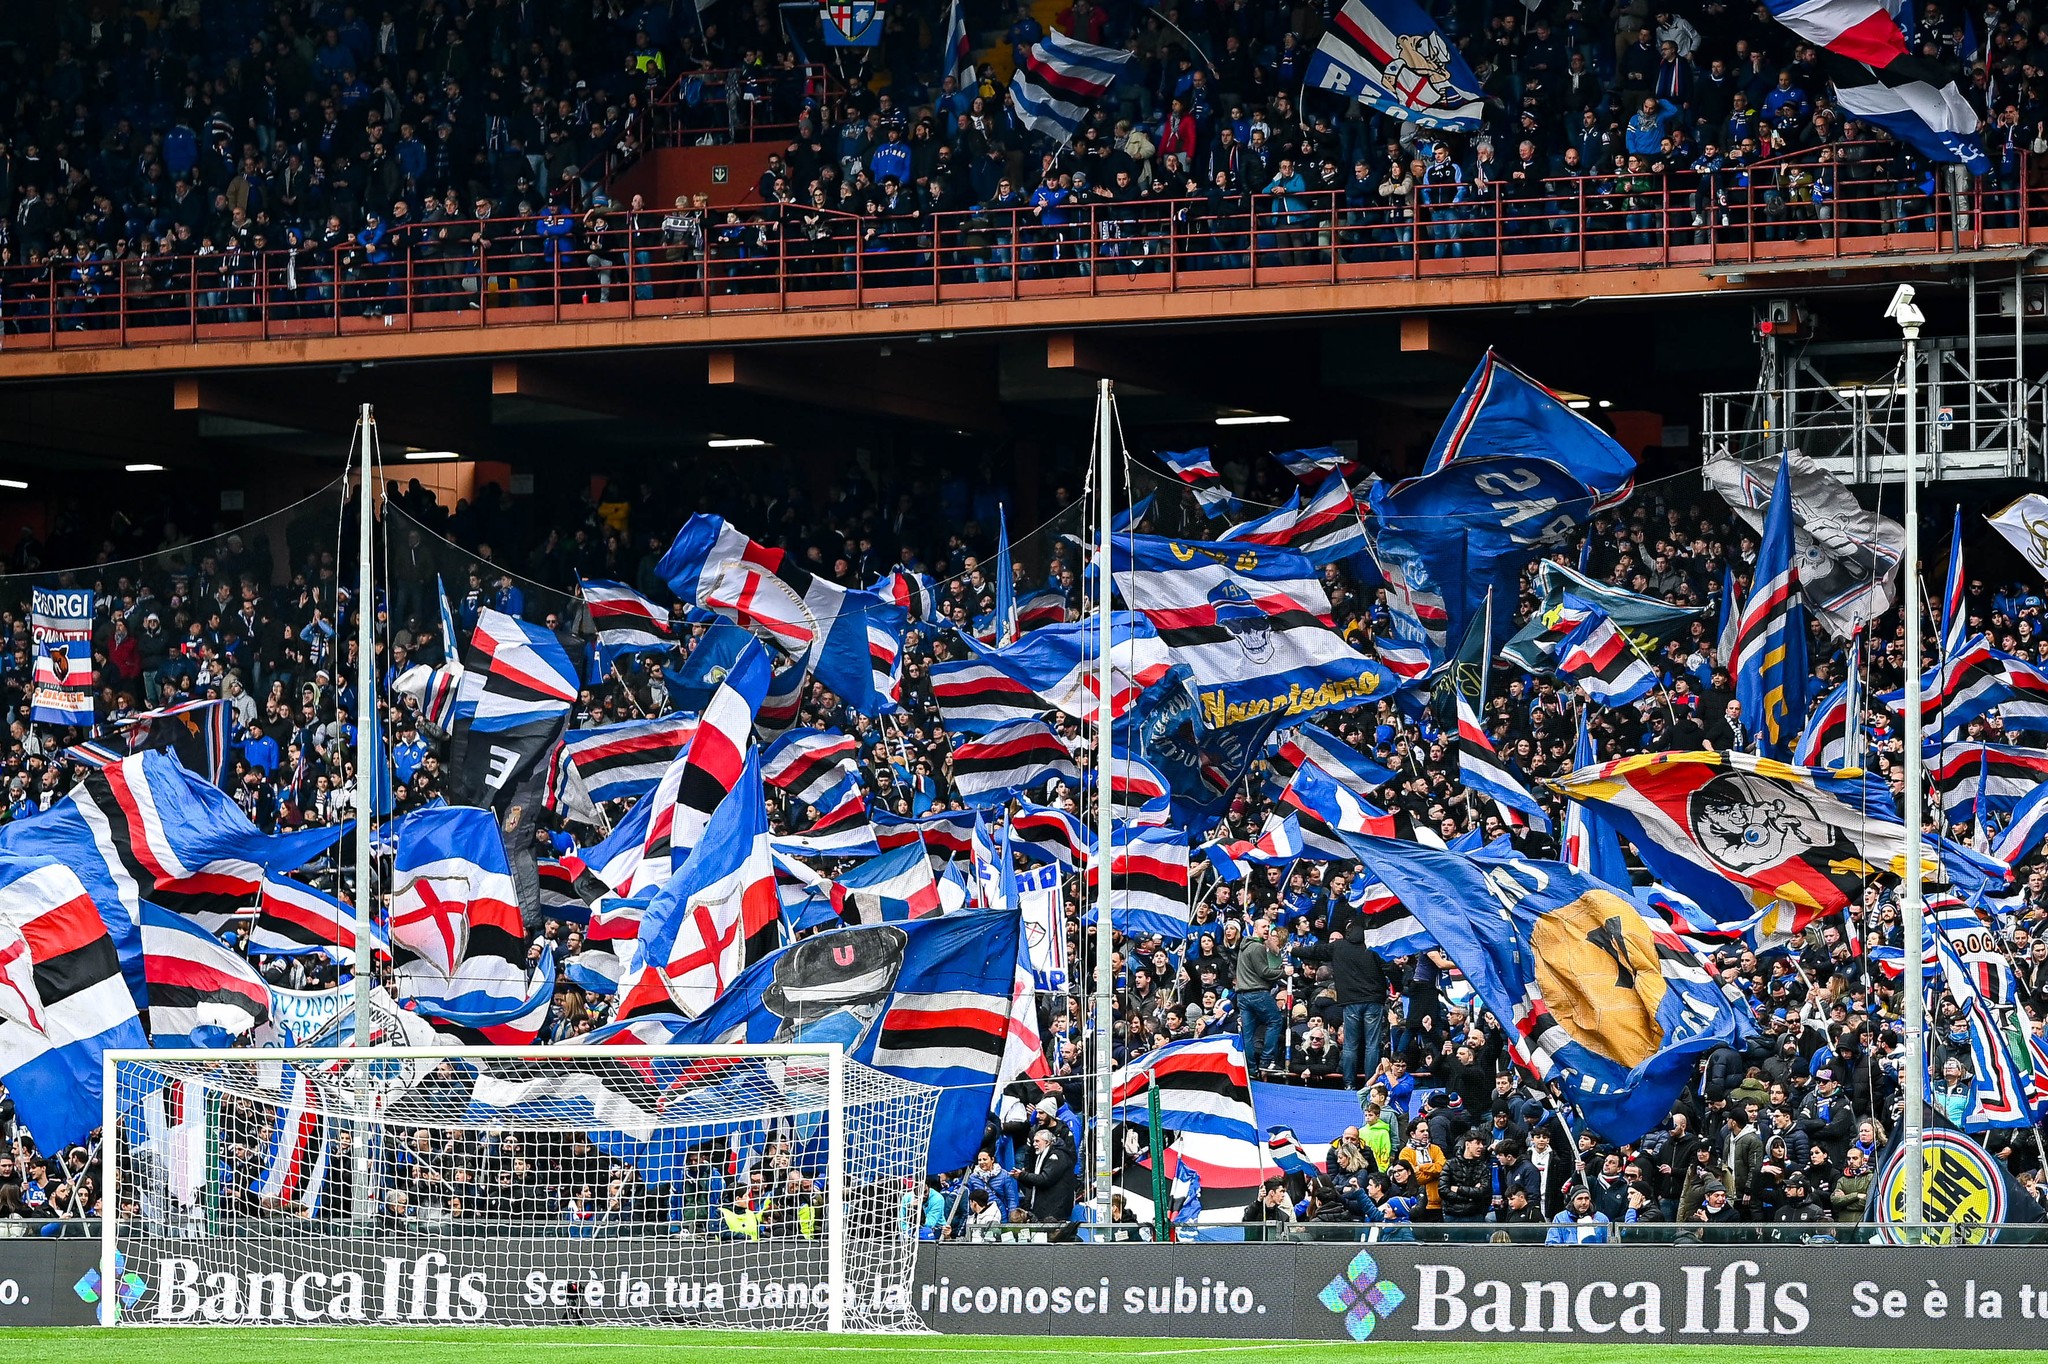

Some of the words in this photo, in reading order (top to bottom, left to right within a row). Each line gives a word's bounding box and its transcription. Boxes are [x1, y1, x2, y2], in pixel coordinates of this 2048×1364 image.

[152, 1257, 366, 1322] Banca
[380, 1251, 488, 1321] Ifis
[584, 1270, 606, 1307] è
[618, 1271, 651, 1308] la
[664, 1276, 724, 1309] tua
[922, 1277, 1109, 1314] riconosci
[1123, 1276, 1267, 1315] subito.
[1412, 1264, 1665, 1334] Banca
[1679, 1260, 1811, 1335] Ifis
[1851, 1280, 1906, 1318] Se
[1923, 1279, 1949, 1319] è
[1965, 1280, 2003, 1319] la
